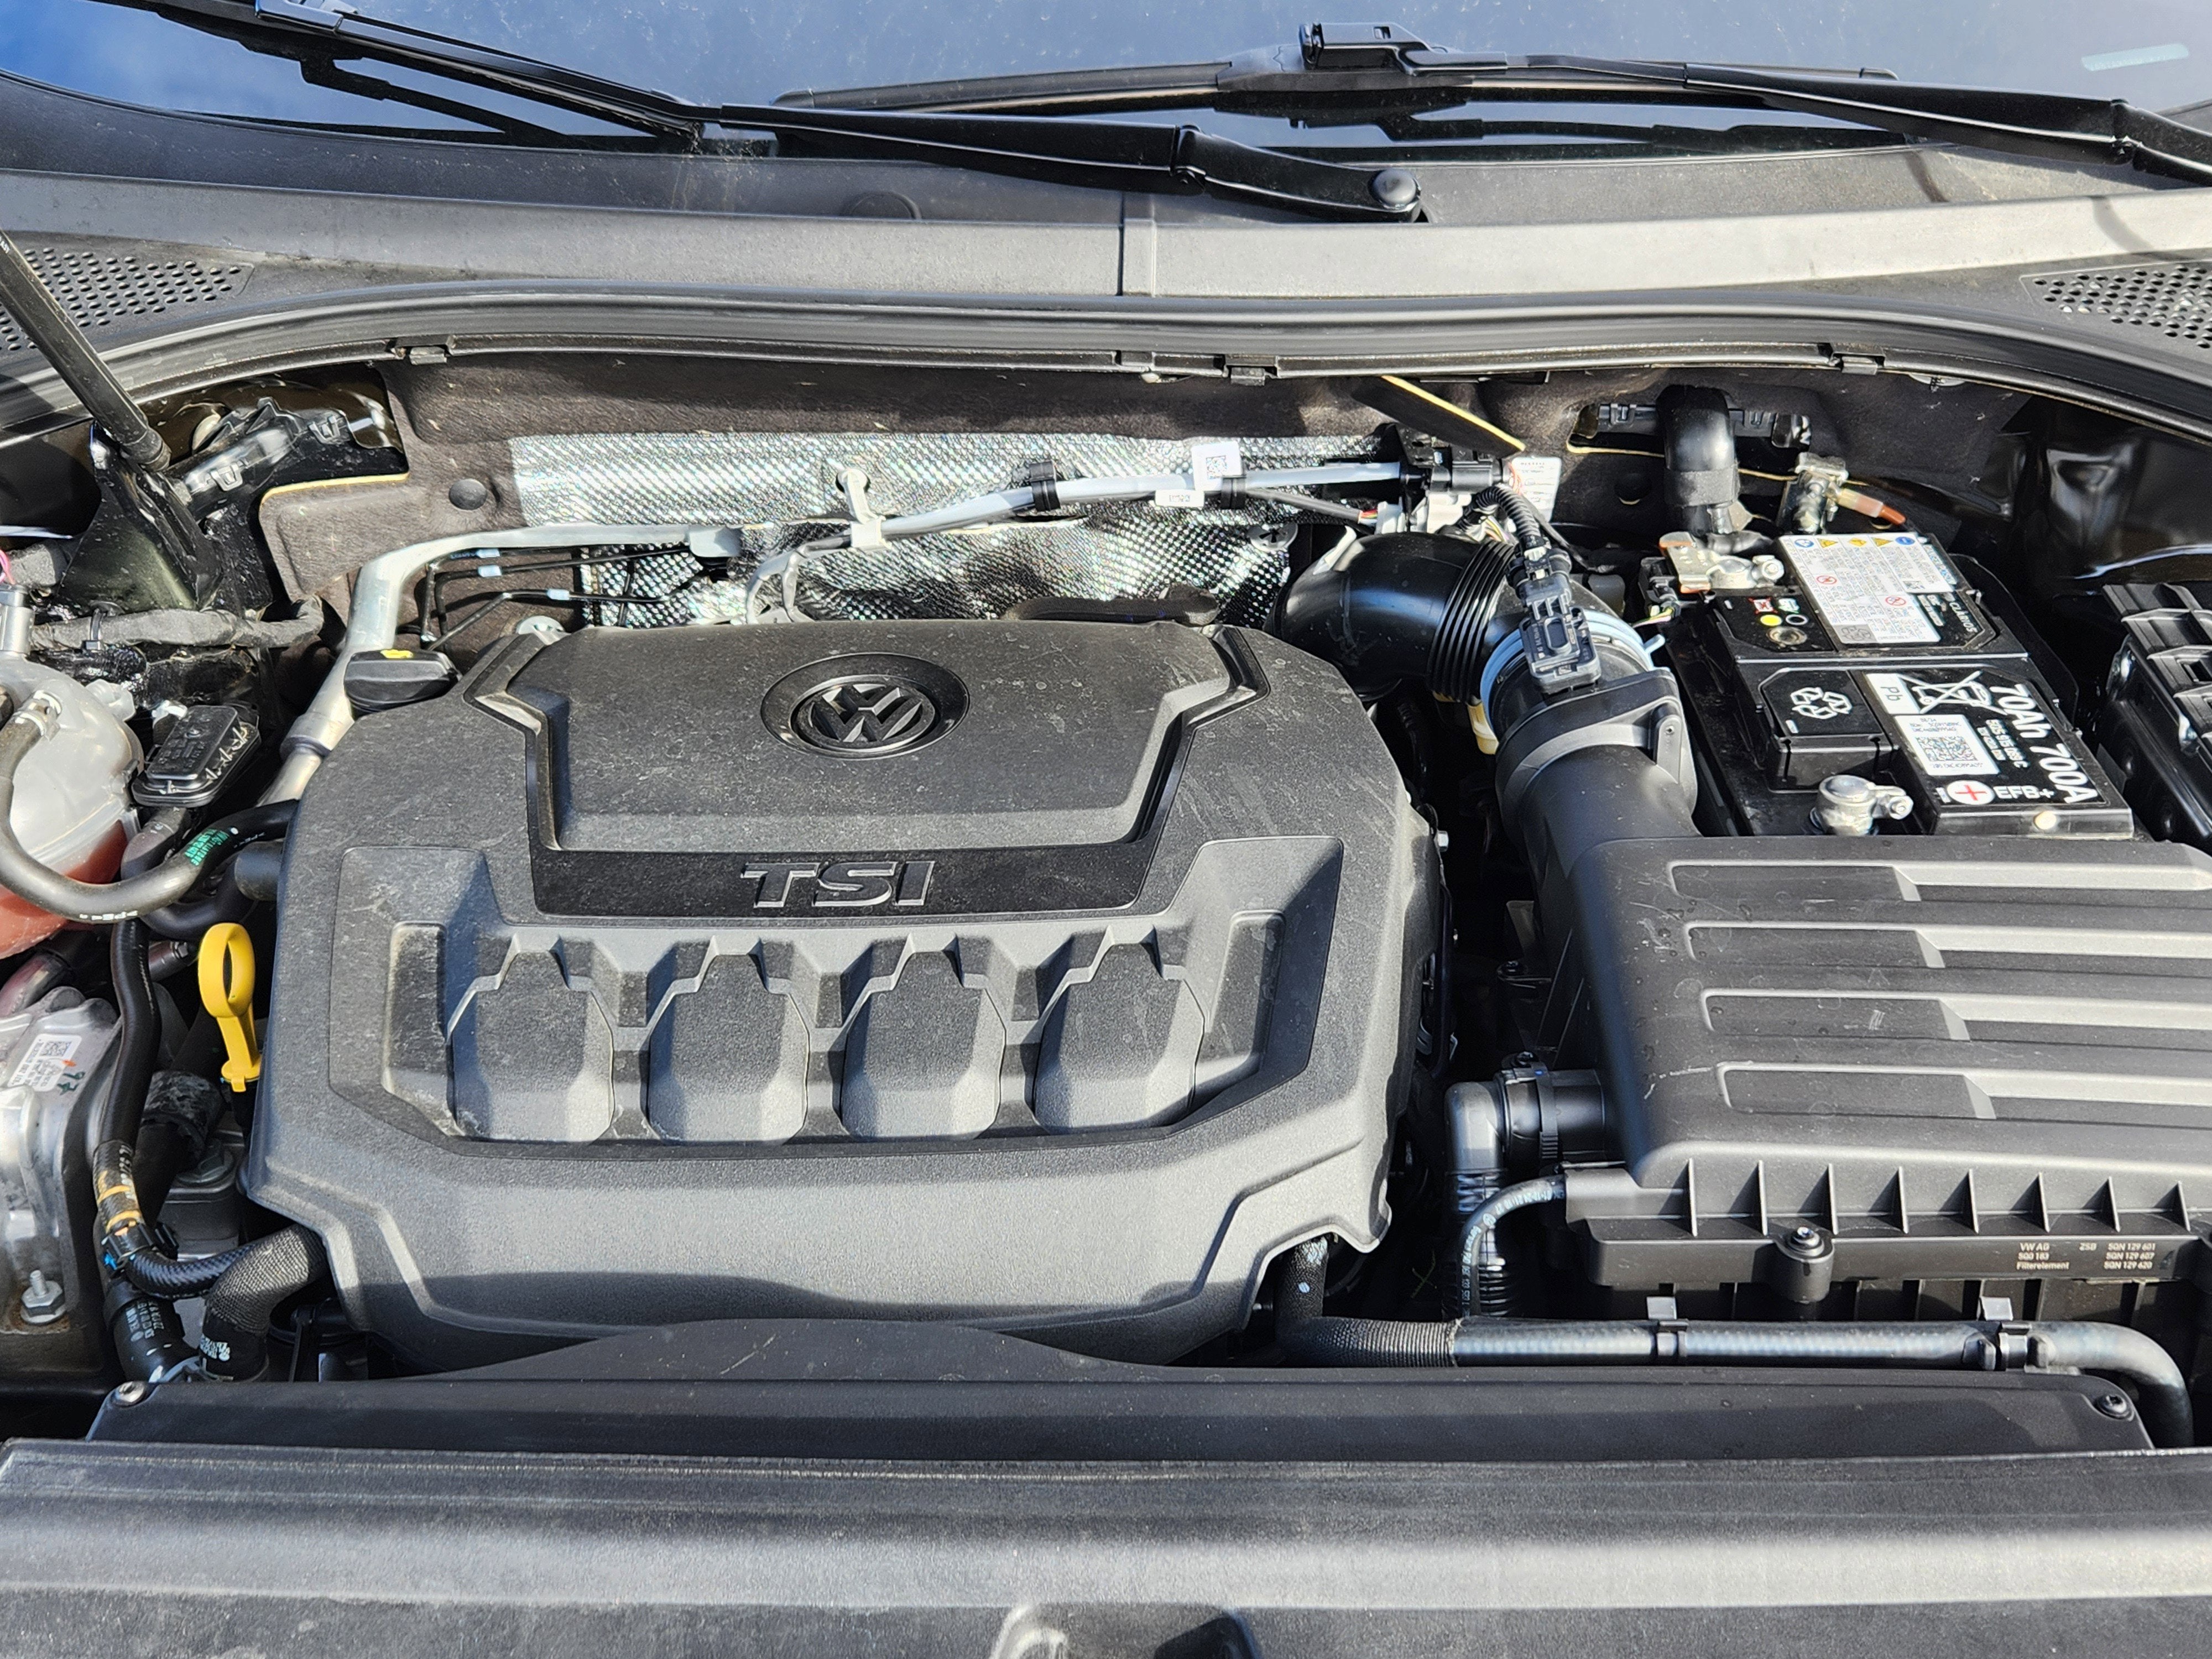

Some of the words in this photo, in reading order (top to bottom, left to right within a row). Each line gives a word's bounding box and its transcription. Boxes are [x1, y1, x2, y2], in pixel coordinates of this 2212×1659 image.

[1880, 687, 1903, 701] Pb
[1989, 684, 2052, 738] 70Ah
[2029, 743, 2099, 803] 700A
[1993, 785, 2055, 799] EFB+
[740, 860, 936, 908] TSI
[2020, 1243, 2036, 1251] VW
